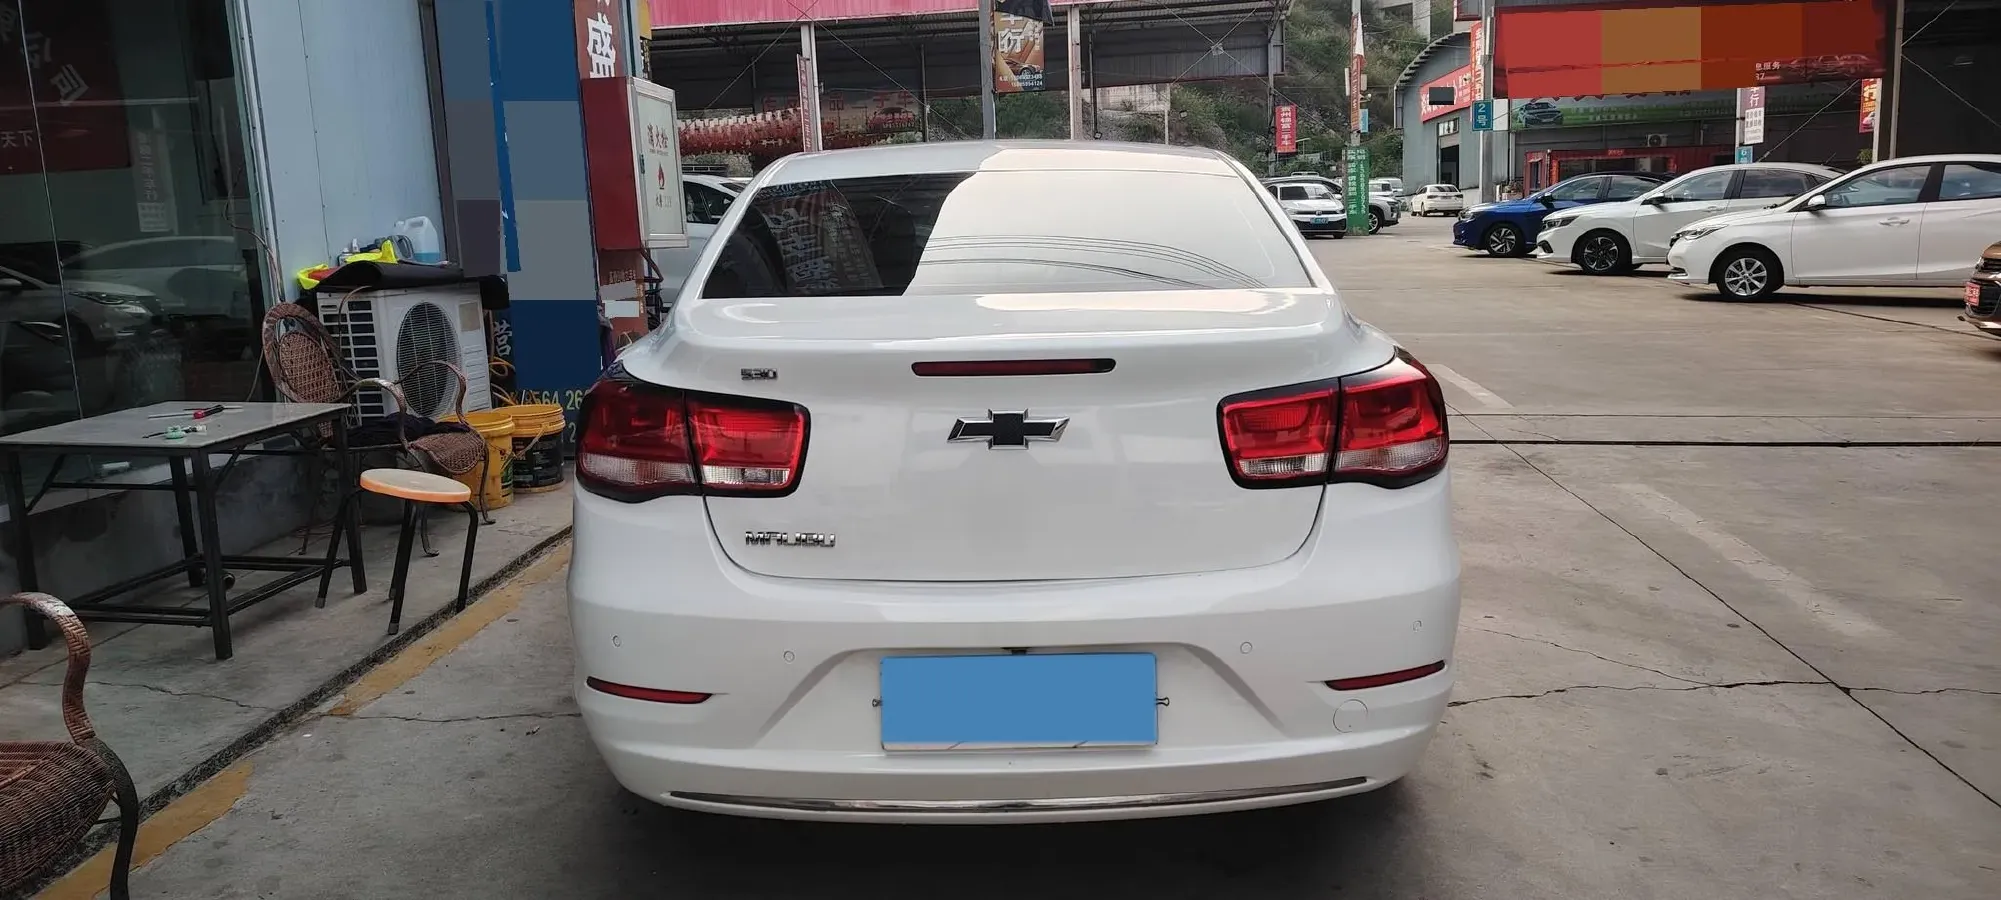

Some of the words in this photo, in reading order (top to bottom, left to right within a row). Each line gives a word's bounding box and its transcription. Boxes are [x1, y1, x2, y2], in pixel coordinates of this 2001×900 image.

[586, 0, 616, 78] 盛
[495, 320, 513, 356] 营
[745, 531, 835, 547] MALIBU
